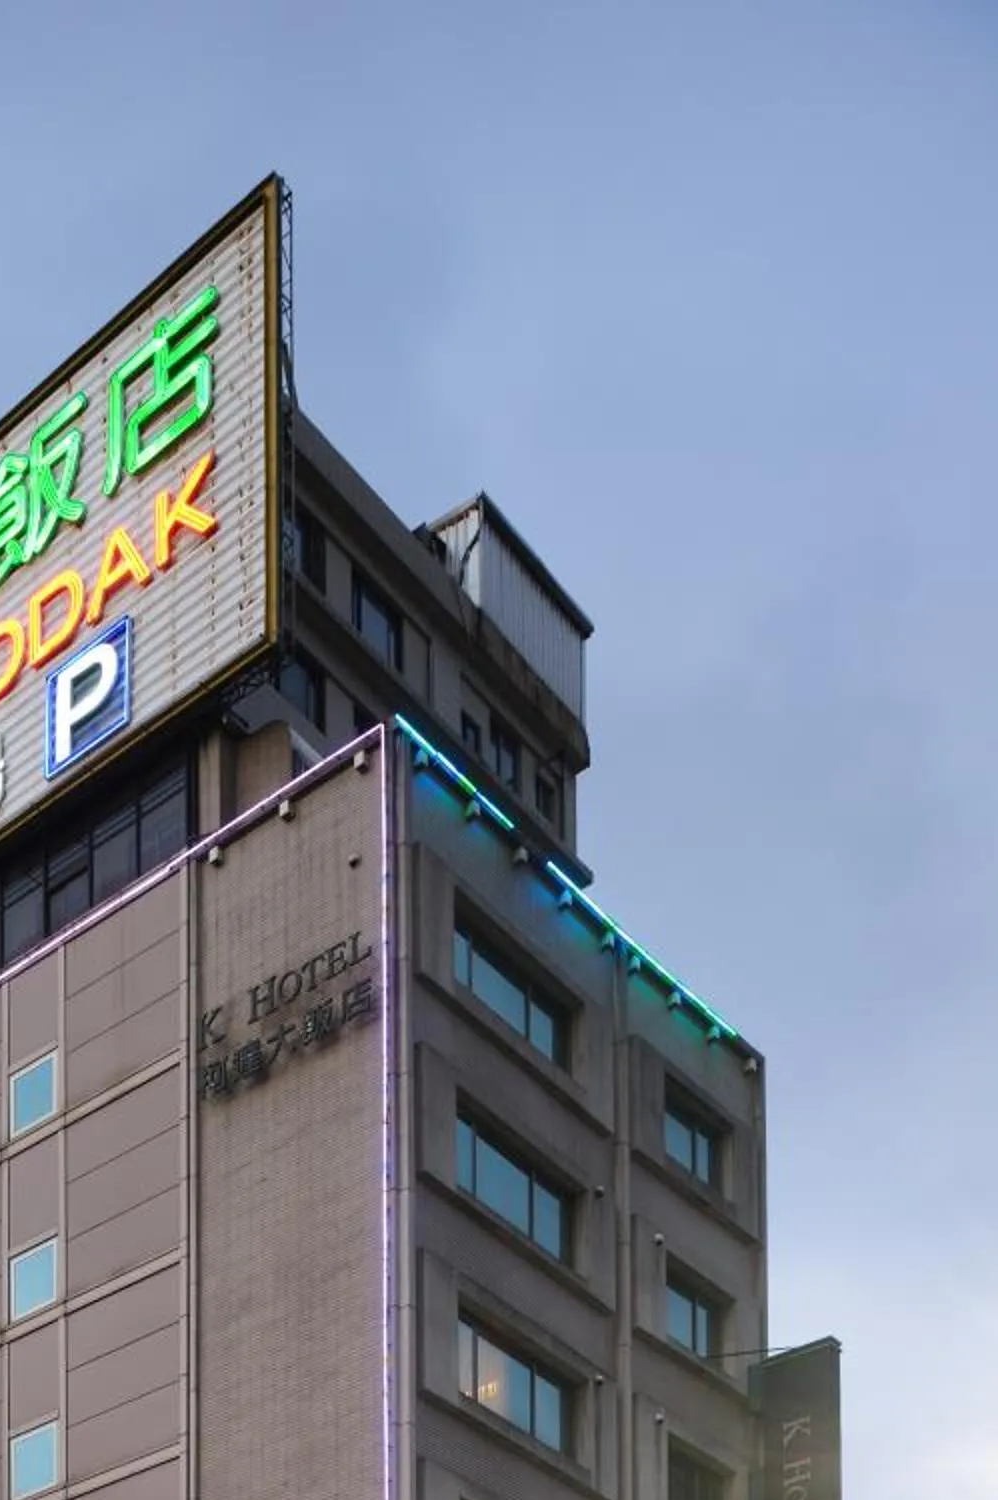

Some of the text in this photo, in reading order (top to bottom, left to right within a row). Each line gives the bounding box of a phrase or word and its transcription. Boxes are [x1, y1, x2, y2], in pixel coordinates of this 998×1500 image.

[54, 641, 117, 762] P
[200, 930, 372, 1051] K HOTEL
[783, 1416, 811, 1449] K
